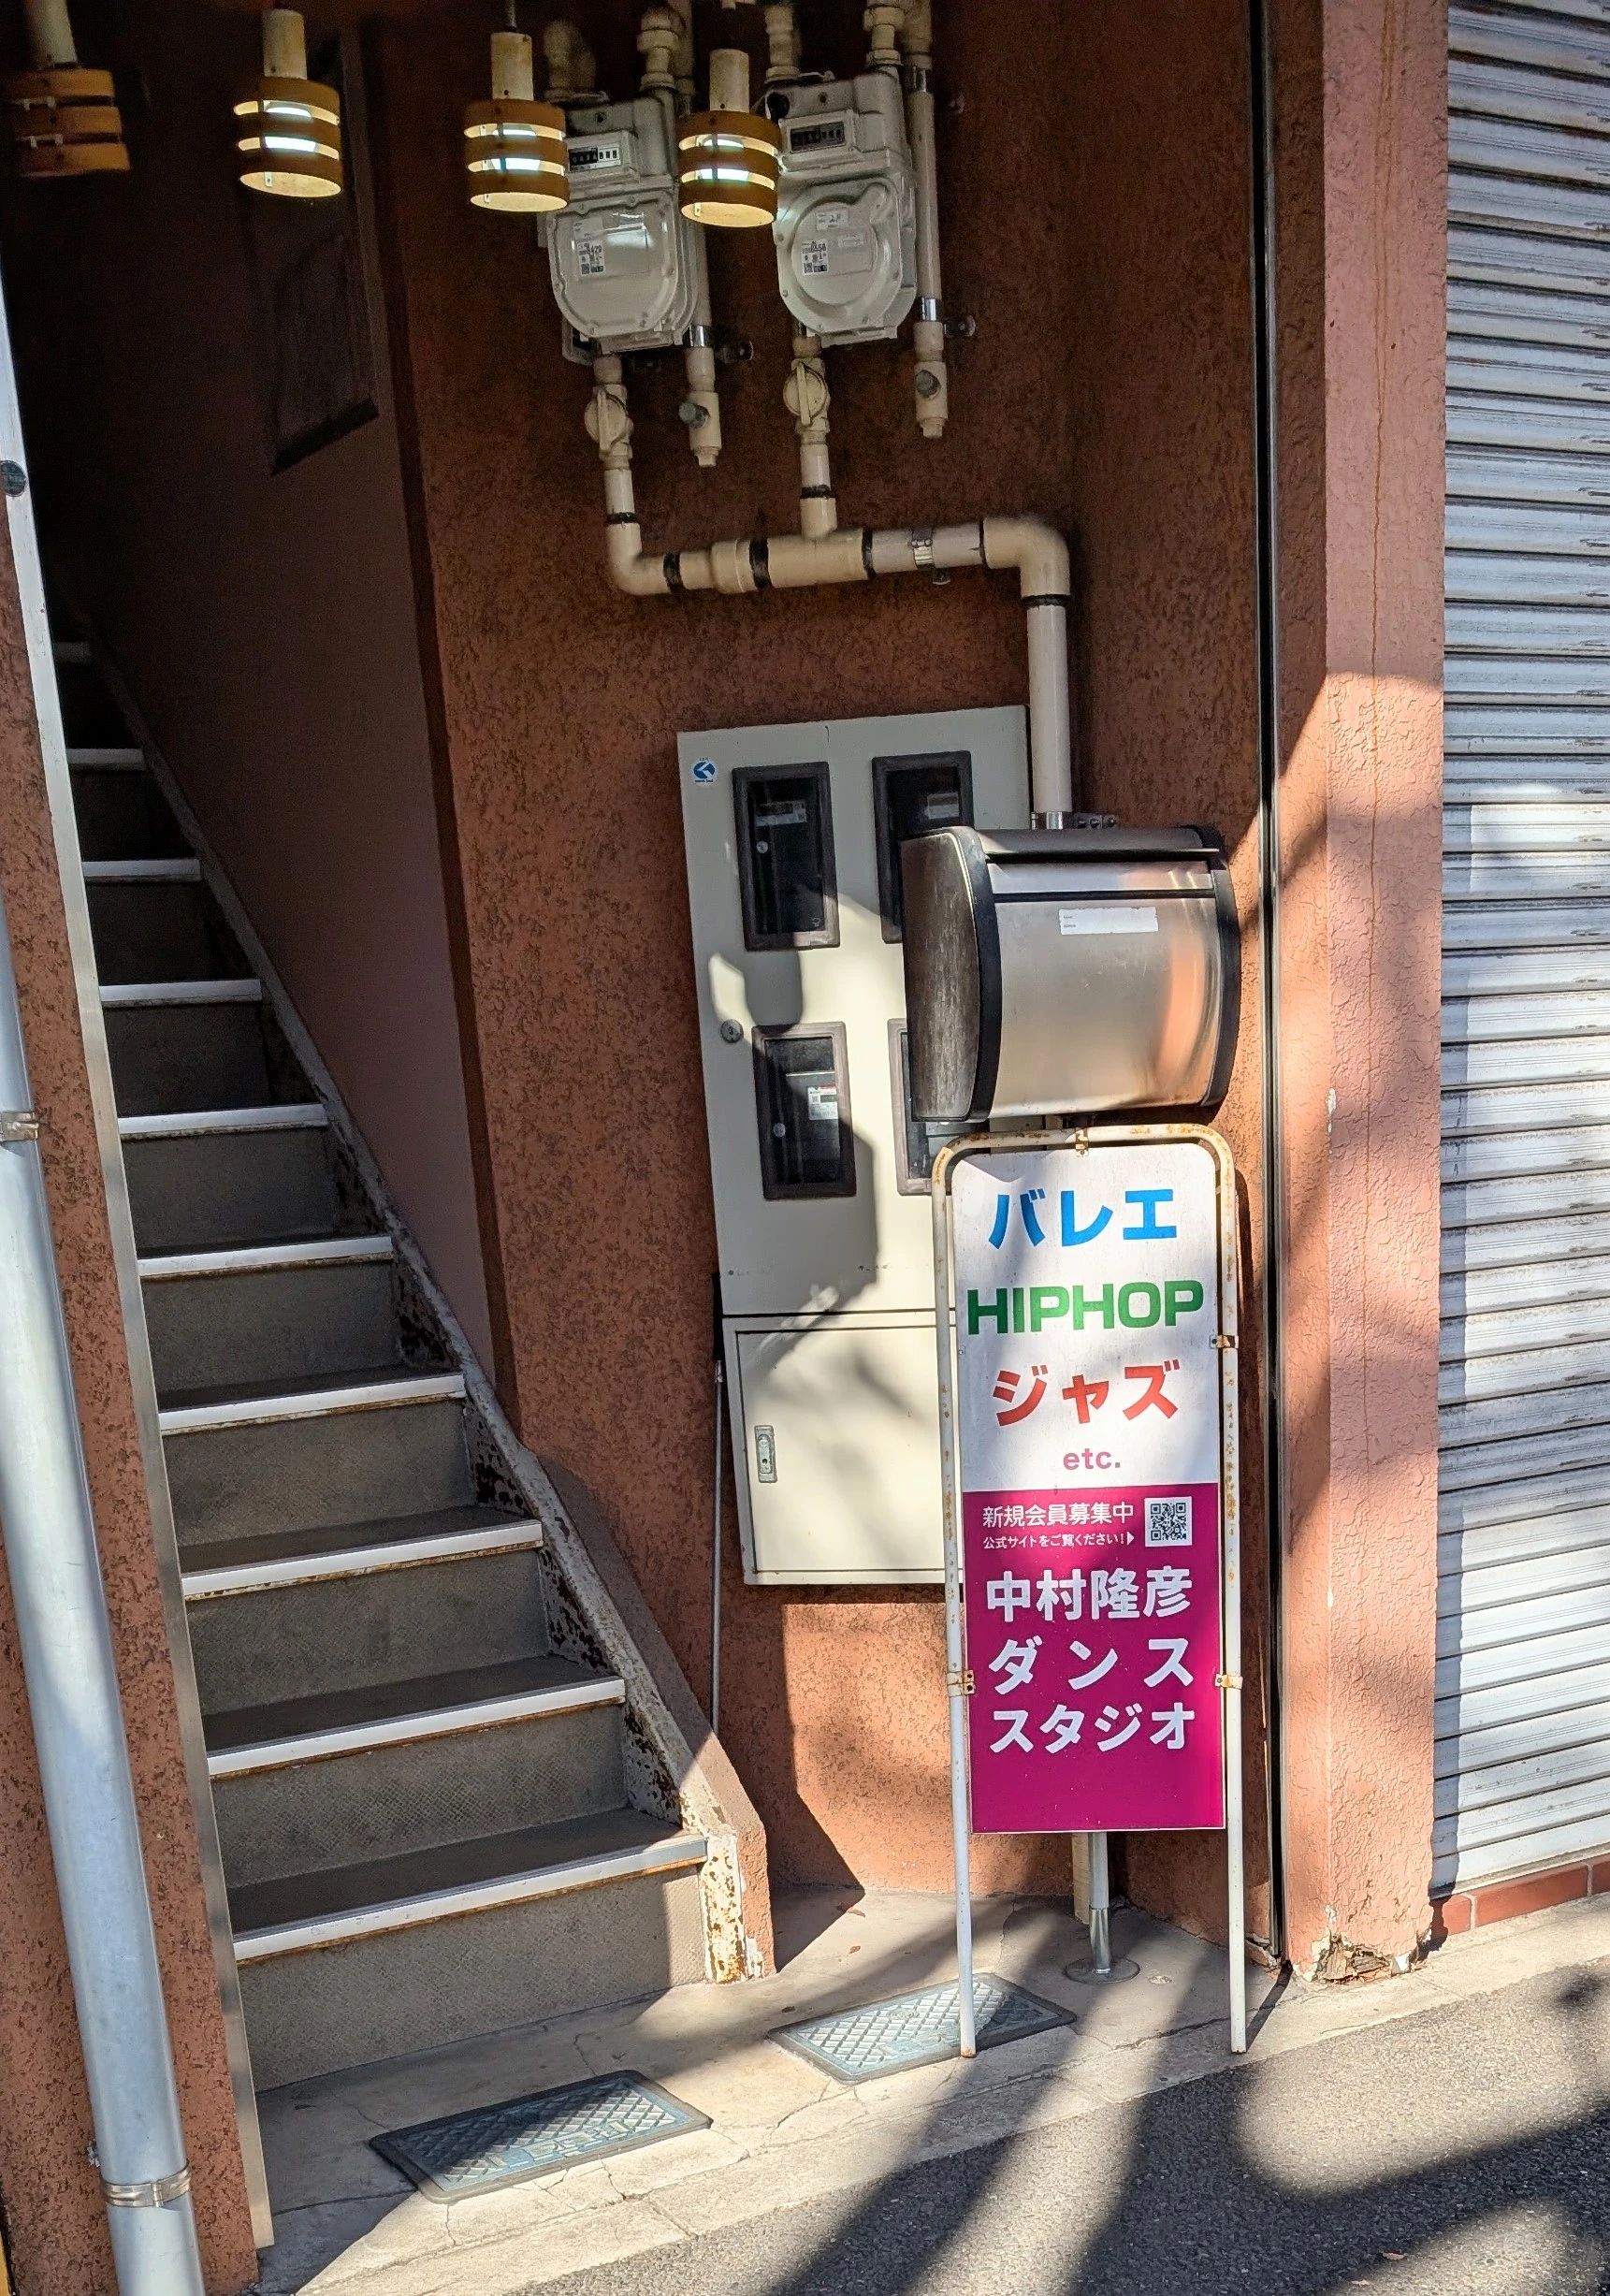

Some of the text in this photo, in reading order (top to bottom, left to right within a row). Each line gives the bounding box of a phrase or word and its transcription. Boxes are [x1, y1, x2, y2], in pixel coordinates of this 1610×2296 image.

[989, 1188, 1177, 1249] バレエ
[967, 1280, 1204, 1334] HIPHOP
[993, 1359, 1181, 1426] ジャズ
[1063, 1448, 1121, 1470] etc.
[982, 1502, 1134, 1528] 新規会員募集中
[986, 1566, 1193, 1621] 中村隆彦
[988, 1635, 1195, 1695] ダンス
[989, 1702, 1196, 1753] スタジオ
